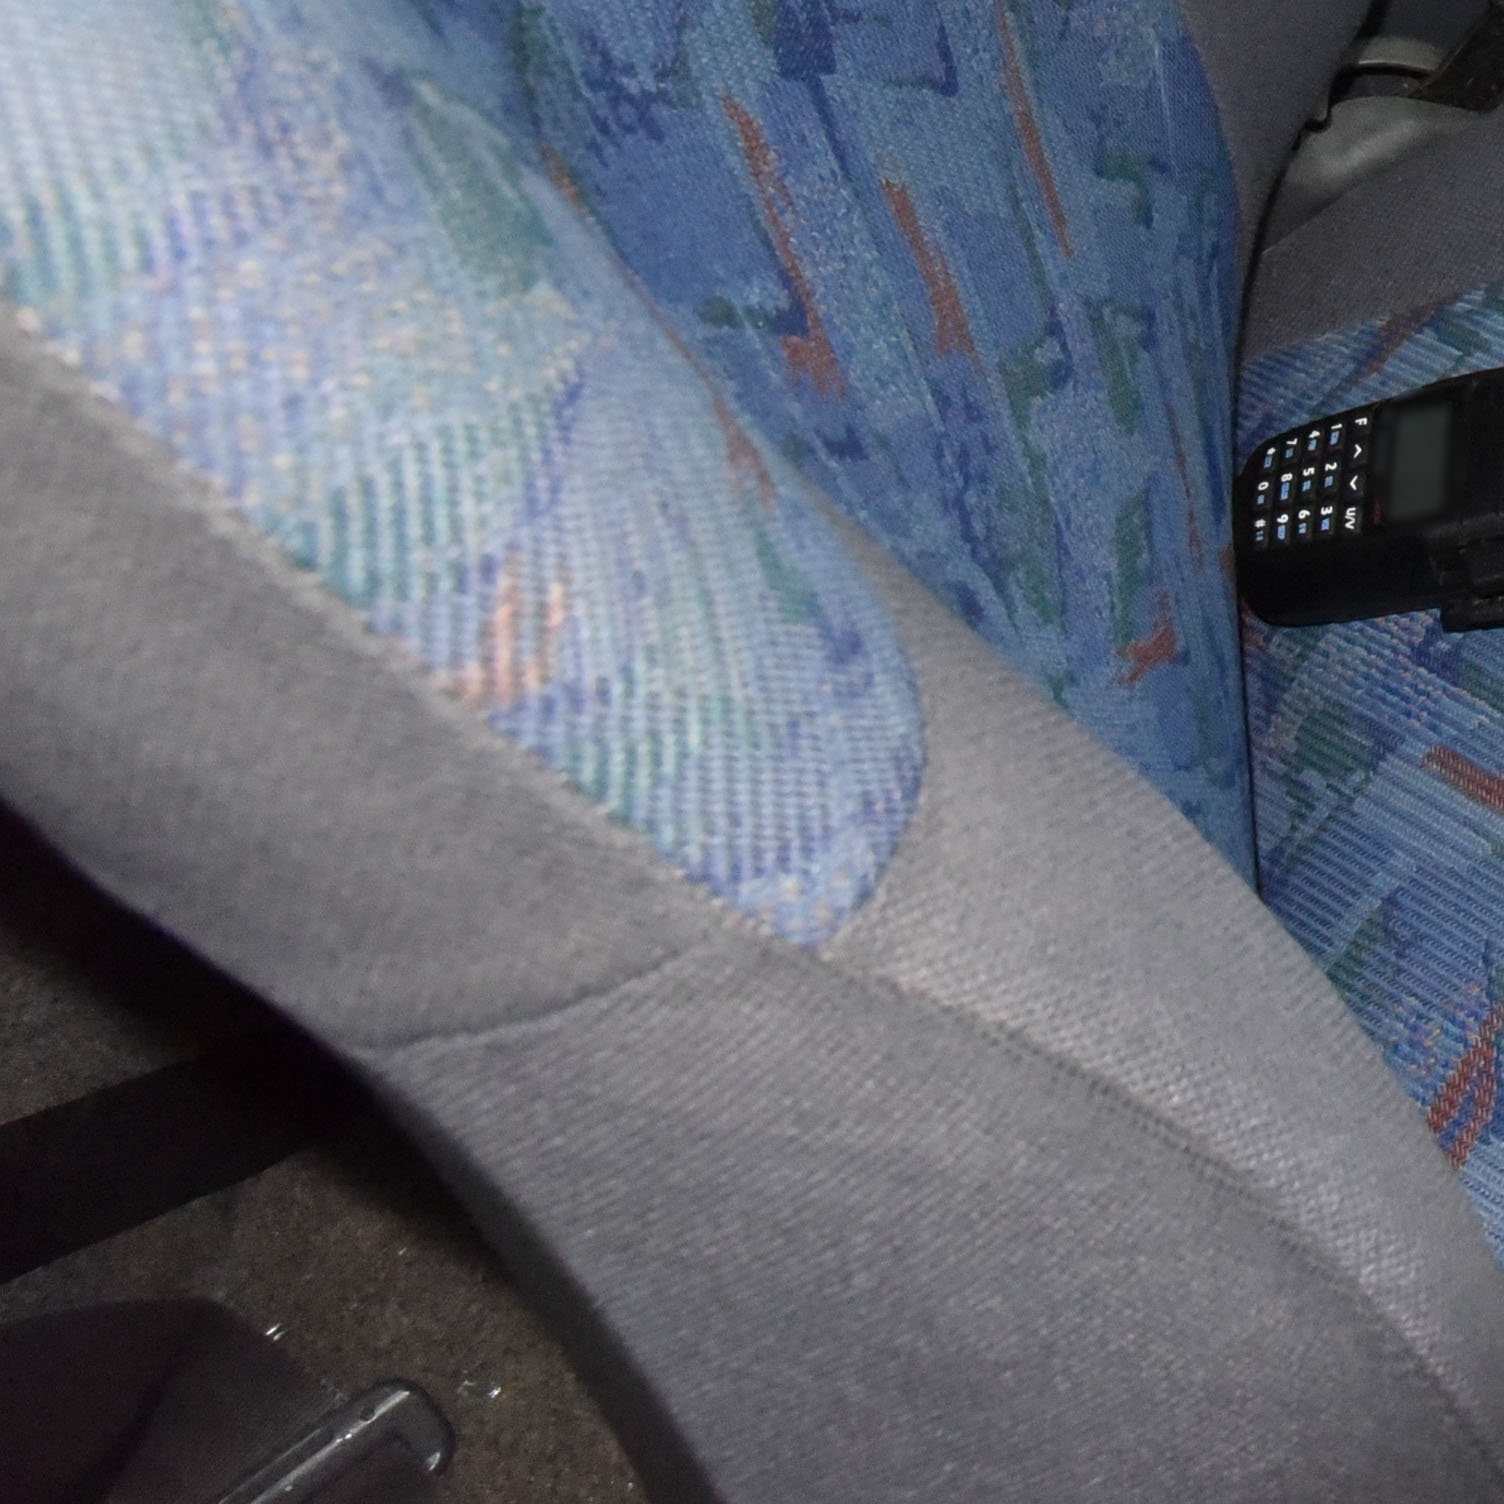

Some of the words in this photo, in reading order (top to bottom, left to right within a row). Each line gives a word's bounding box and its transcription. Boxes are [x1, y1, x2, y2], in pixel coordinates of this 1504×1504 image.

[1355, 417, 1368, 426] F
[1309, 430, 1321, 439] 4
[1286, 438, 1298, 446] 7
[1325, 462, 1338, 471] 2
[1303, 467, 1315, 477] 5
[1281, 473, 1293, 483] 8
[1257, 481, 1269, 491] 0
[1298, 509, 1311, 520] 6
[1320, 505, 1333, 516] 3
[1276, 514, 1289, 524] 9
